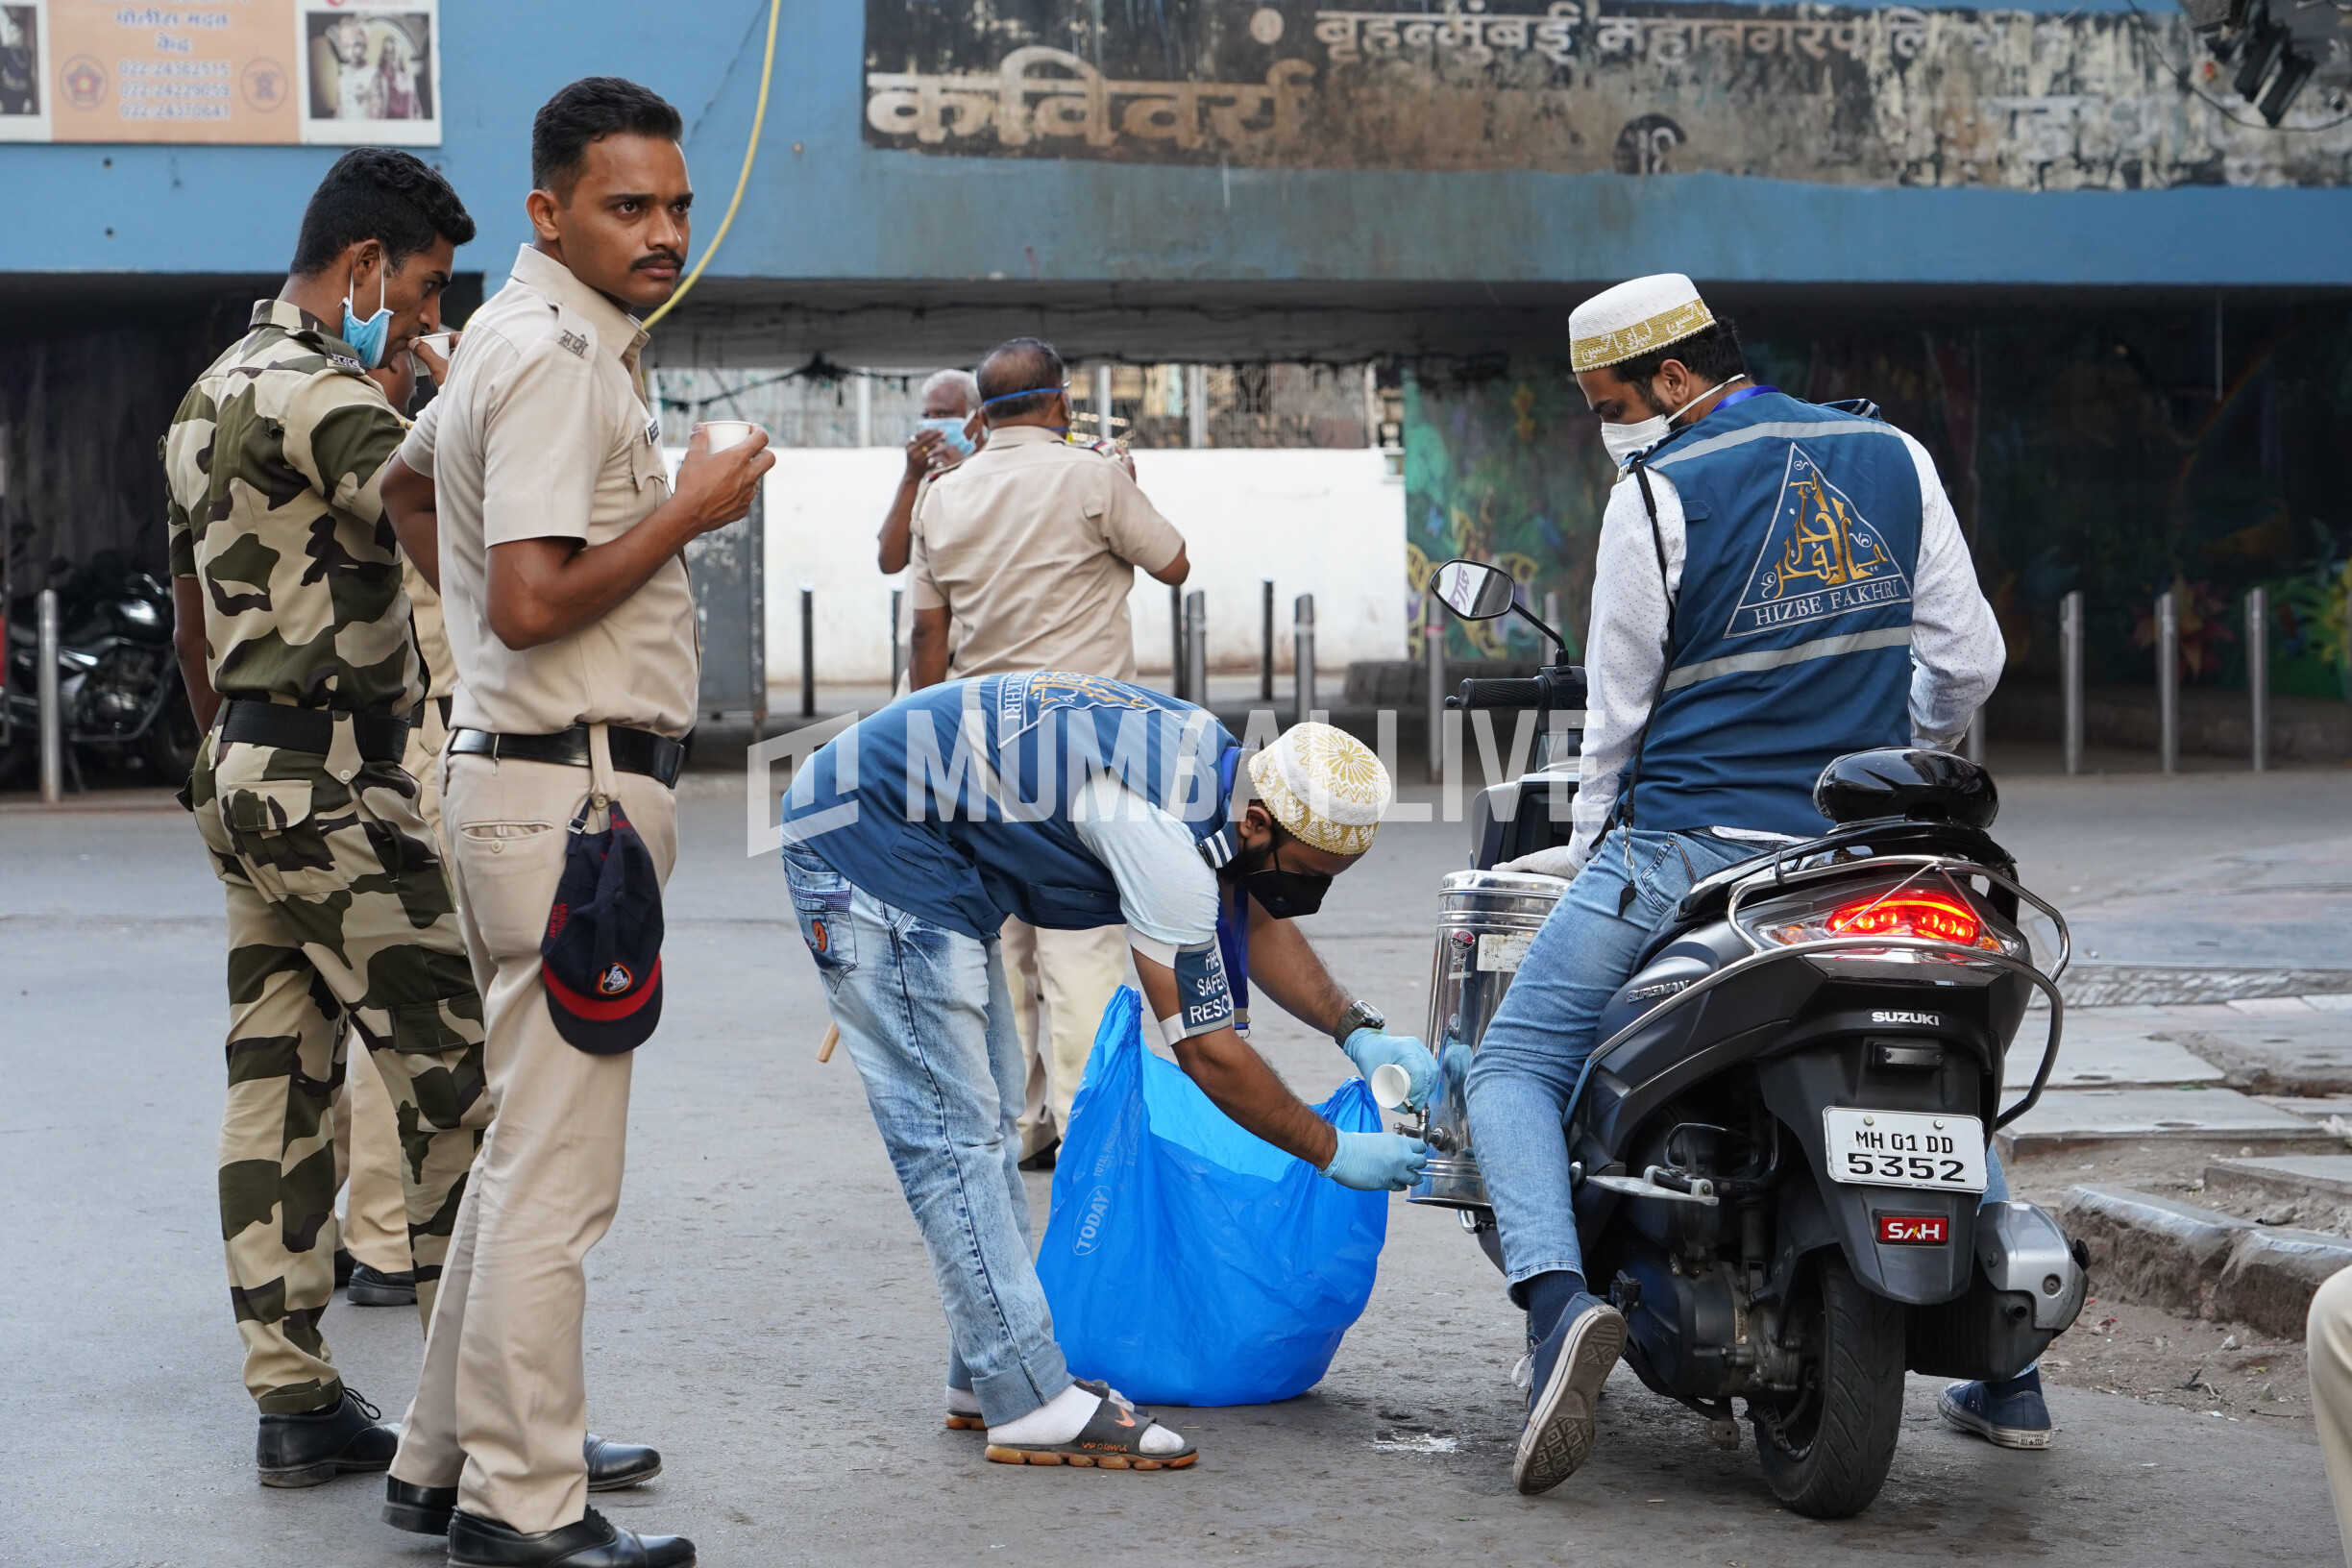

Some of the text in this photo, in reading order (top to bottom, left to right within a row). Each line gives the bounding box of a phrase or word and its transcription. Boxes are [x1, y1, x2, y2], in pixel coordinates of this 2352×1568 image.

[1753, 578, 1900, 626] HIZBE FAKHRI
[1872, 1011, 1940, 1026] SUZUKI
[1855, 1131, 1953, 1154] MH 01 DD
[1847, 1152, 1966, 1183] 5352
[1076, 1189, 1110, 1249] TODAY
